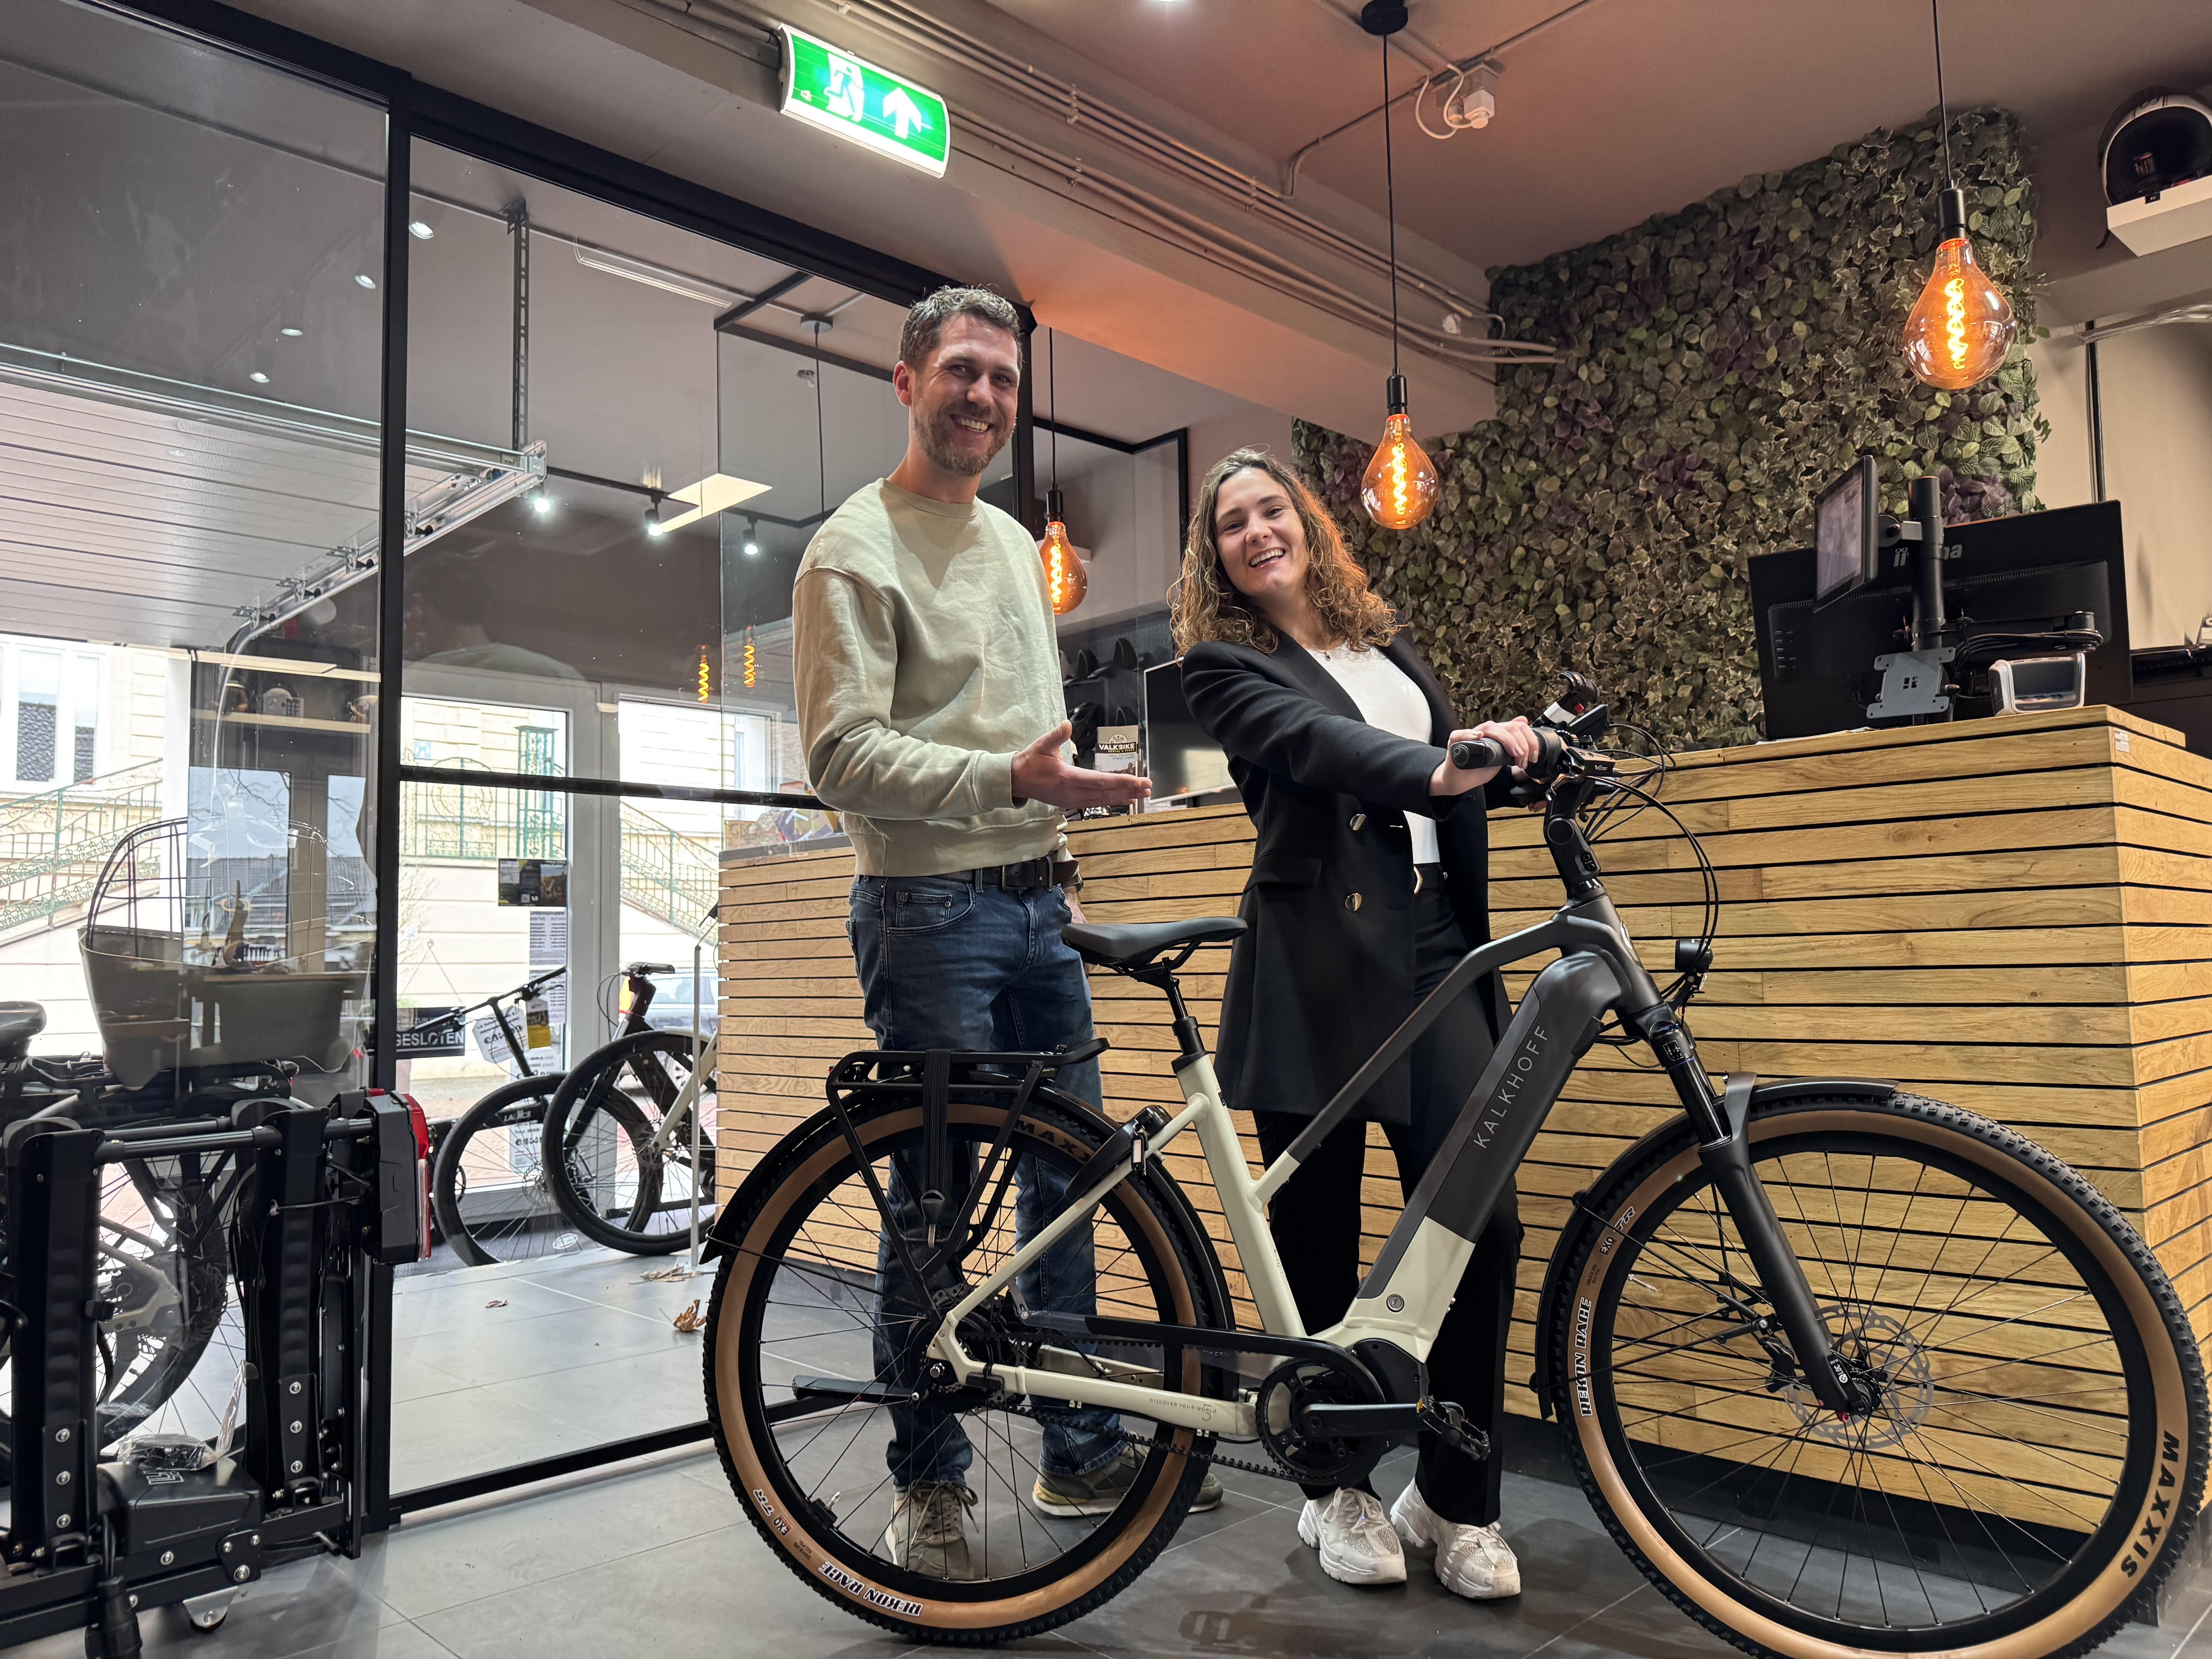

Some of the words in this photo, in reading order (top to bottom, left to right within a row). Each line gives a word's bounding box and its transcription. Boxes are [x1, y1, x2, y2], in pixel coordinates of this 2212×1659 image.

[1474, 1026, 1547, 1148] KALKHOFF
[1575, 1297, 1592, 1348] RACE
[1575, 1352, 1593, 1417] REKON
[1149, 1398, 1177, 1407] DISCOVER
[1197, 1406, 1217, 1414] WORLD
[2121, 1430, 2180, 1578] MAXXIS
[774, 1518, 788, 1536] EXO
[818, 1561, 865, 1595] RACE
[863, 1587, 924, 1617] REKON
